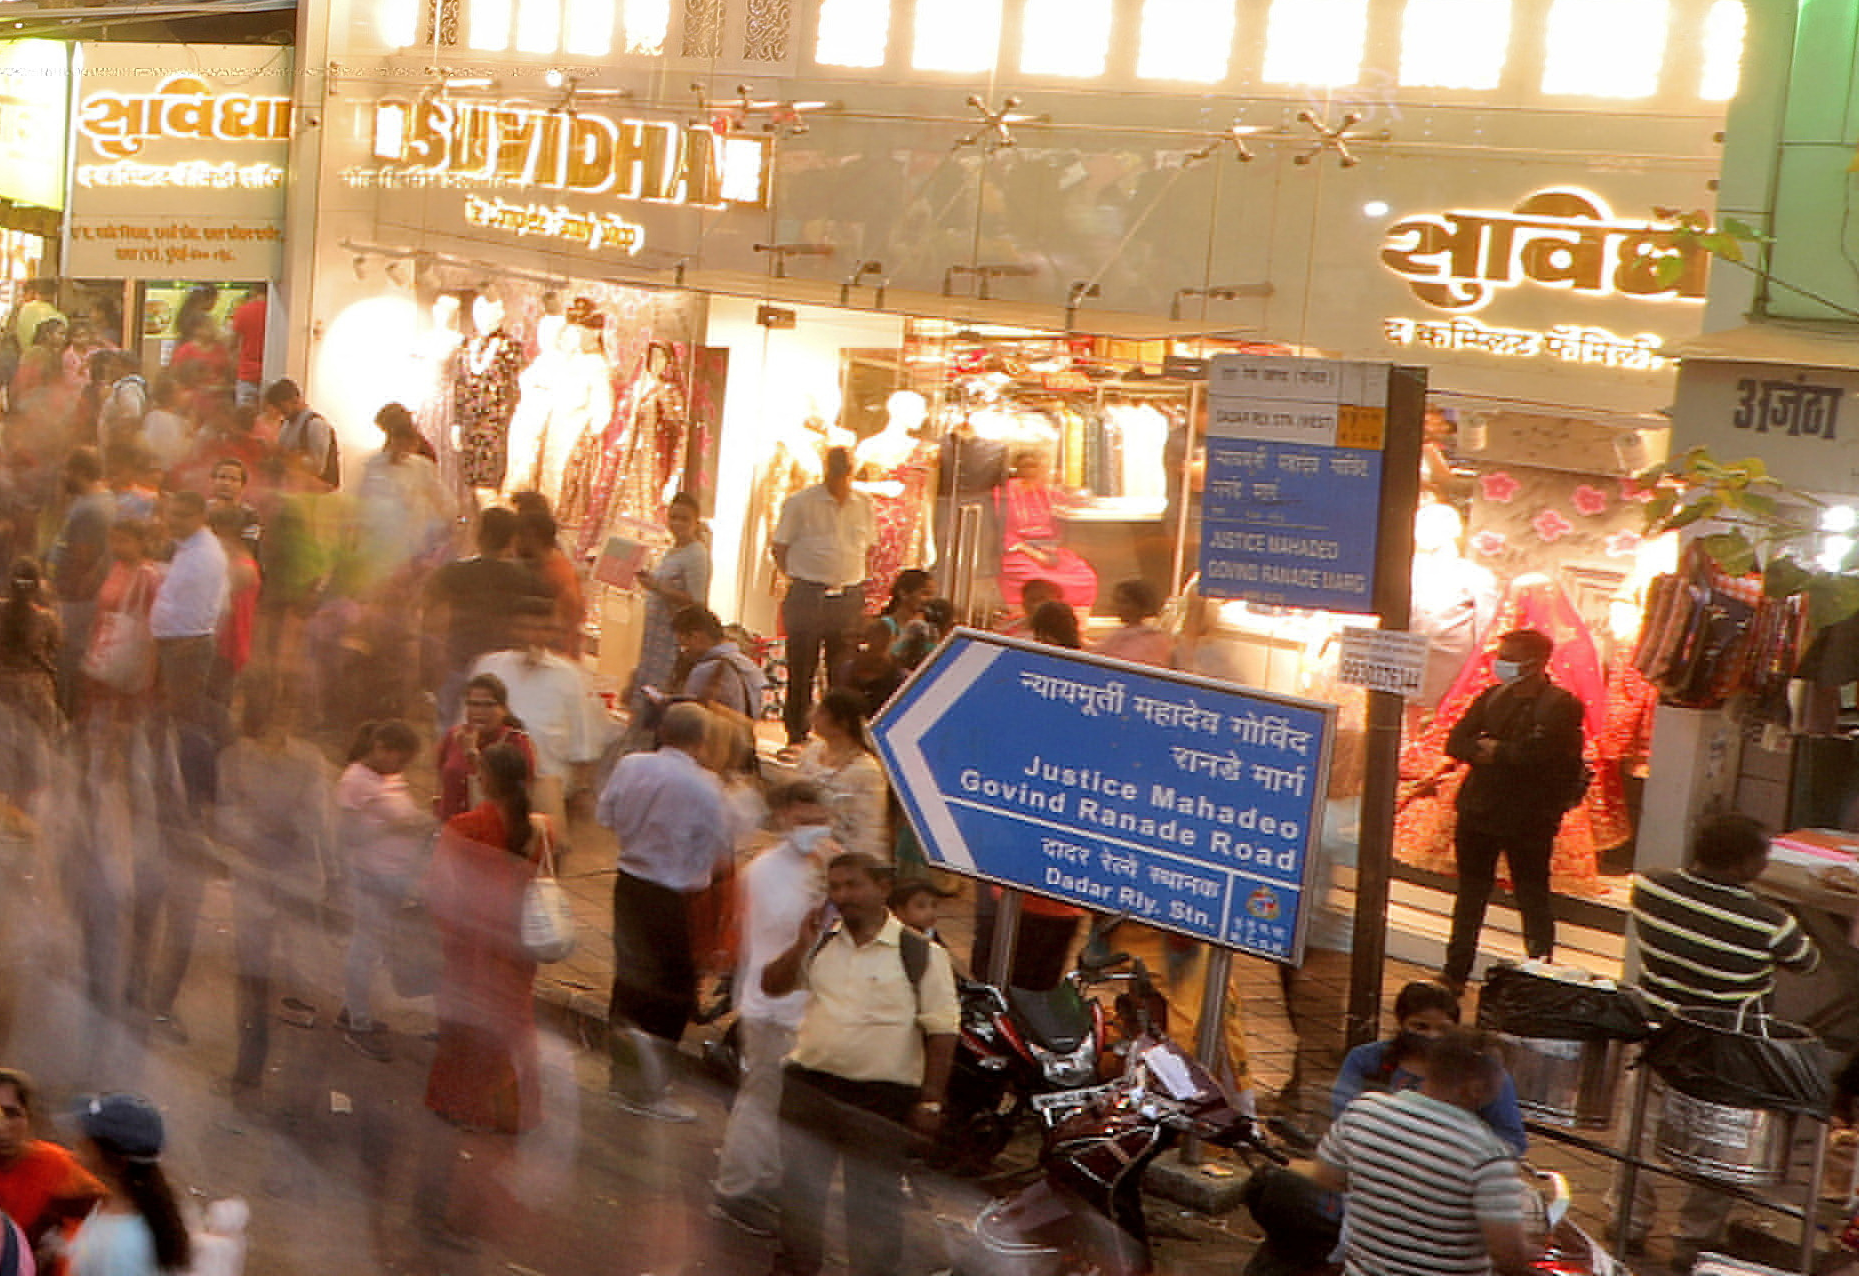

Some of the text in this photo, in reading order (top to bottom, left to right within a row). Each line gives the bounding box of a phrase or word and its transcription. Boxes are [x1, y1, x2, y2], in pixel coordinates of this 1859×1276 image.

[80, 75, 291, 158] सुविधा
[408, 98, 727, 210] SUVIDHA
[1209, 531, 1266, 553] JUSTICE
[1133, 695, 1223, 735] महादेव
[1230, 711, 1314, 756] गोविंद
[1024, 755, 1299, 840] Justice Mahadeo
[1170, 745, 1307, 797] रानडे मार्ग
[960, 771, 1297, 871] Govind Ranade Road
[1046, 867, 1113, 901] Dadar
[1119, 886, 1162, 917] Rly.
